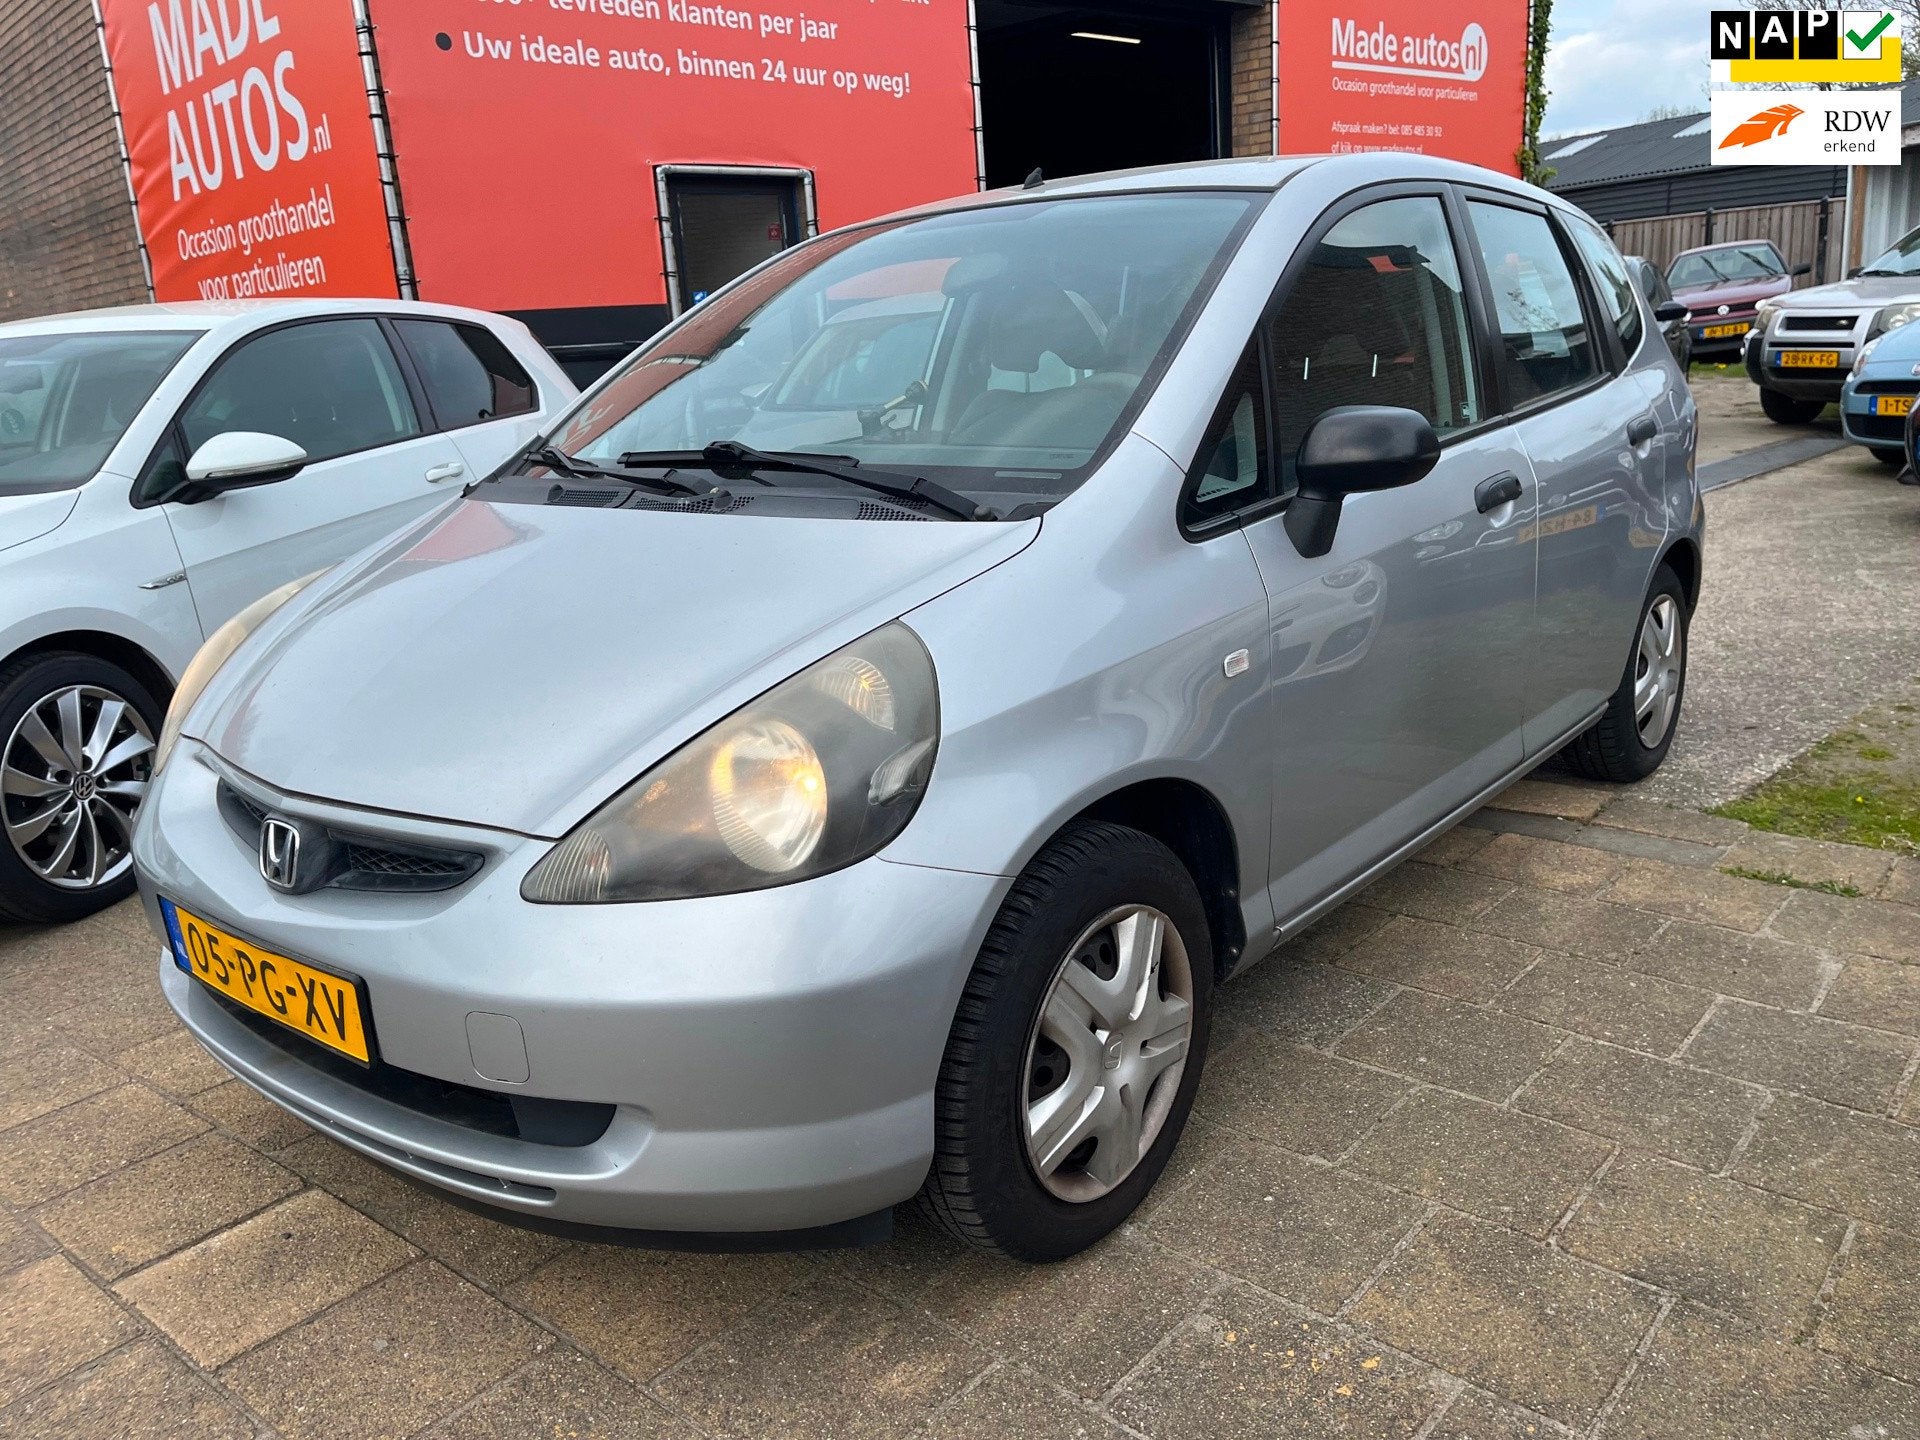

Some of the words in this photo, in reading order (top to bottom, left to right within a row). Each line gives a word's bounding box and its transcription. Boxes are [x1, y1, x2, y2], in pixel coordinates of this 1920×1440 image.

[667, 0, 753, 30] klanten
[758, 13, 794, 38] per
[800, 13, 838, 42] jaar
[1332, 17, 1398, 62] Made
[463, 30, 512, 60] Uw
[519, 33, 600, 67] ideale
[608, 48, 671, 76] auto,
[677, 48, 755, 80] binnen
[761, 58, 787, 83] 24
[792, 66, 827, 86] uur
[832, 70, 858, 94] op
[863, 72, 911, 98] weg!
[1332, 76, 1368, 93] Occasion
[1369, 80, 1417, 97] groothandel
[1417, 87, 1434, 98] voor
[1435, 86, 1478, 101] particulieren
[1331, 120, 1361, 135] Afspraak
[177, 218, 237, 260] Occasion
[238, 183, 336, 256] groothandel
[197, 275, 229, 300] voor
[231, 252, 326, 299] particulieren
[187, 922, 346, 1041] 05-PG-XV
